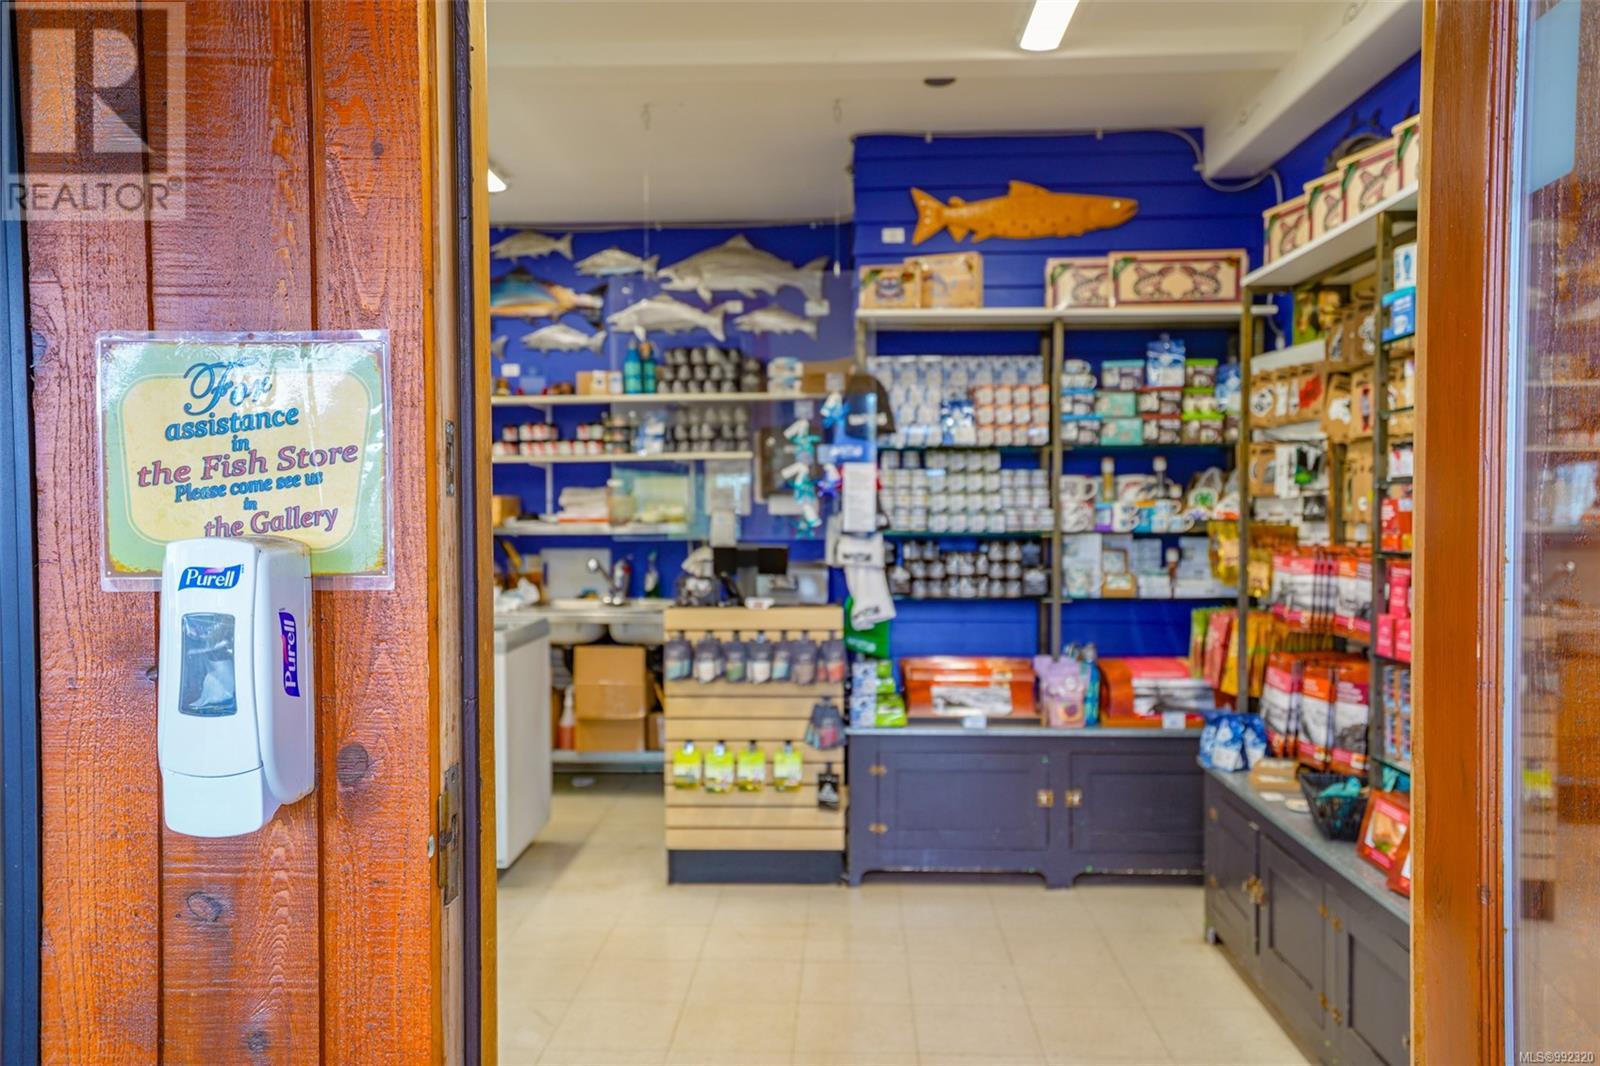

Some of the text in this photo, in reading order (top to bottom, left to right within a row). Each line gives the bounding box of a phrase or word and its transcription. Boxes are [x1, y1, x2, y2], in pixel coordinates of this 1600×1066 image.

[183, 357, 273, 416] For
[164, 406, 300, 442] assistance
[231, 434, 250, 452] in
[137, 444, 359, 487] the Fish Store
[174, 471, 324, 503] Please come see us
[243, 497, 258, 511] in
[204, 505, 339, 537] the Gallery
[185, 568, 235, 588] Purell
[284, 618, 297, 689] Purell
